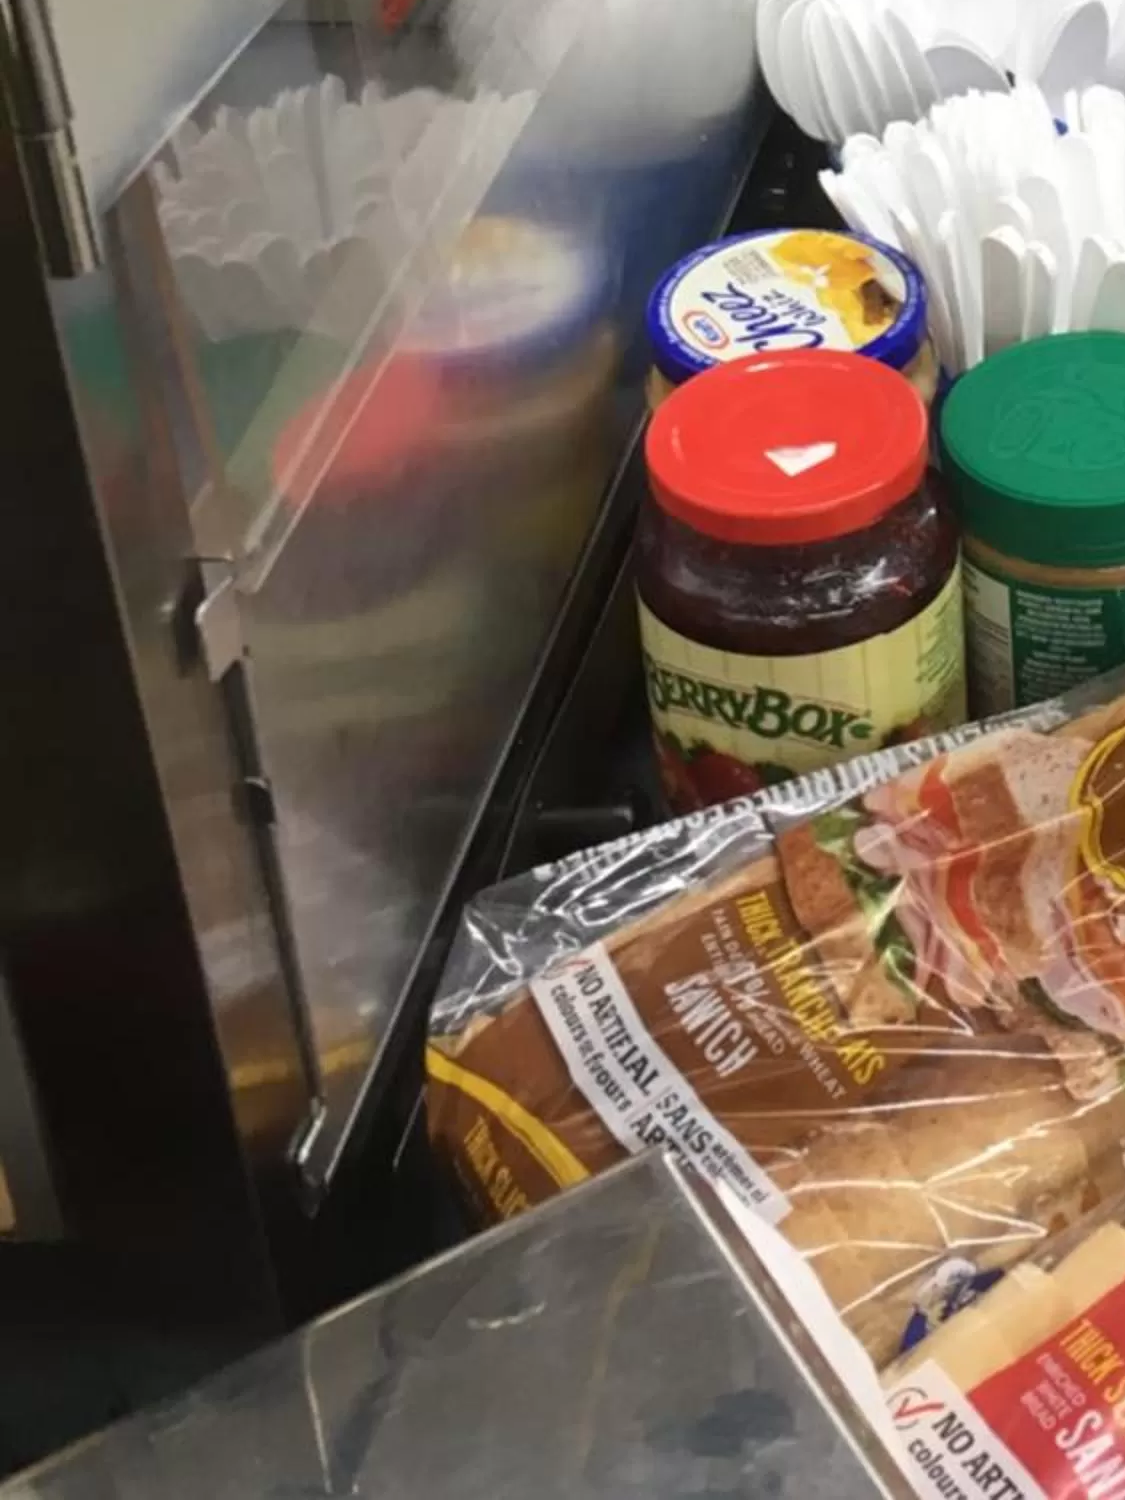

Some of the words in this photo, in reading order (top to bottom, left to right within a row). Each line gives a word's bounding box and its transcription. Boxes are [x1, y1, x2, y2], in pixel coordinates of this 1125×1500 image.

[550, 983, 591, 1046] colours
[573, 962, 604, 997] NO
[655, 1091, 712, 1155] SANS
[1060, 1318, 1125, 1384] THICK
[930, 1411, 976, 1454] NO
